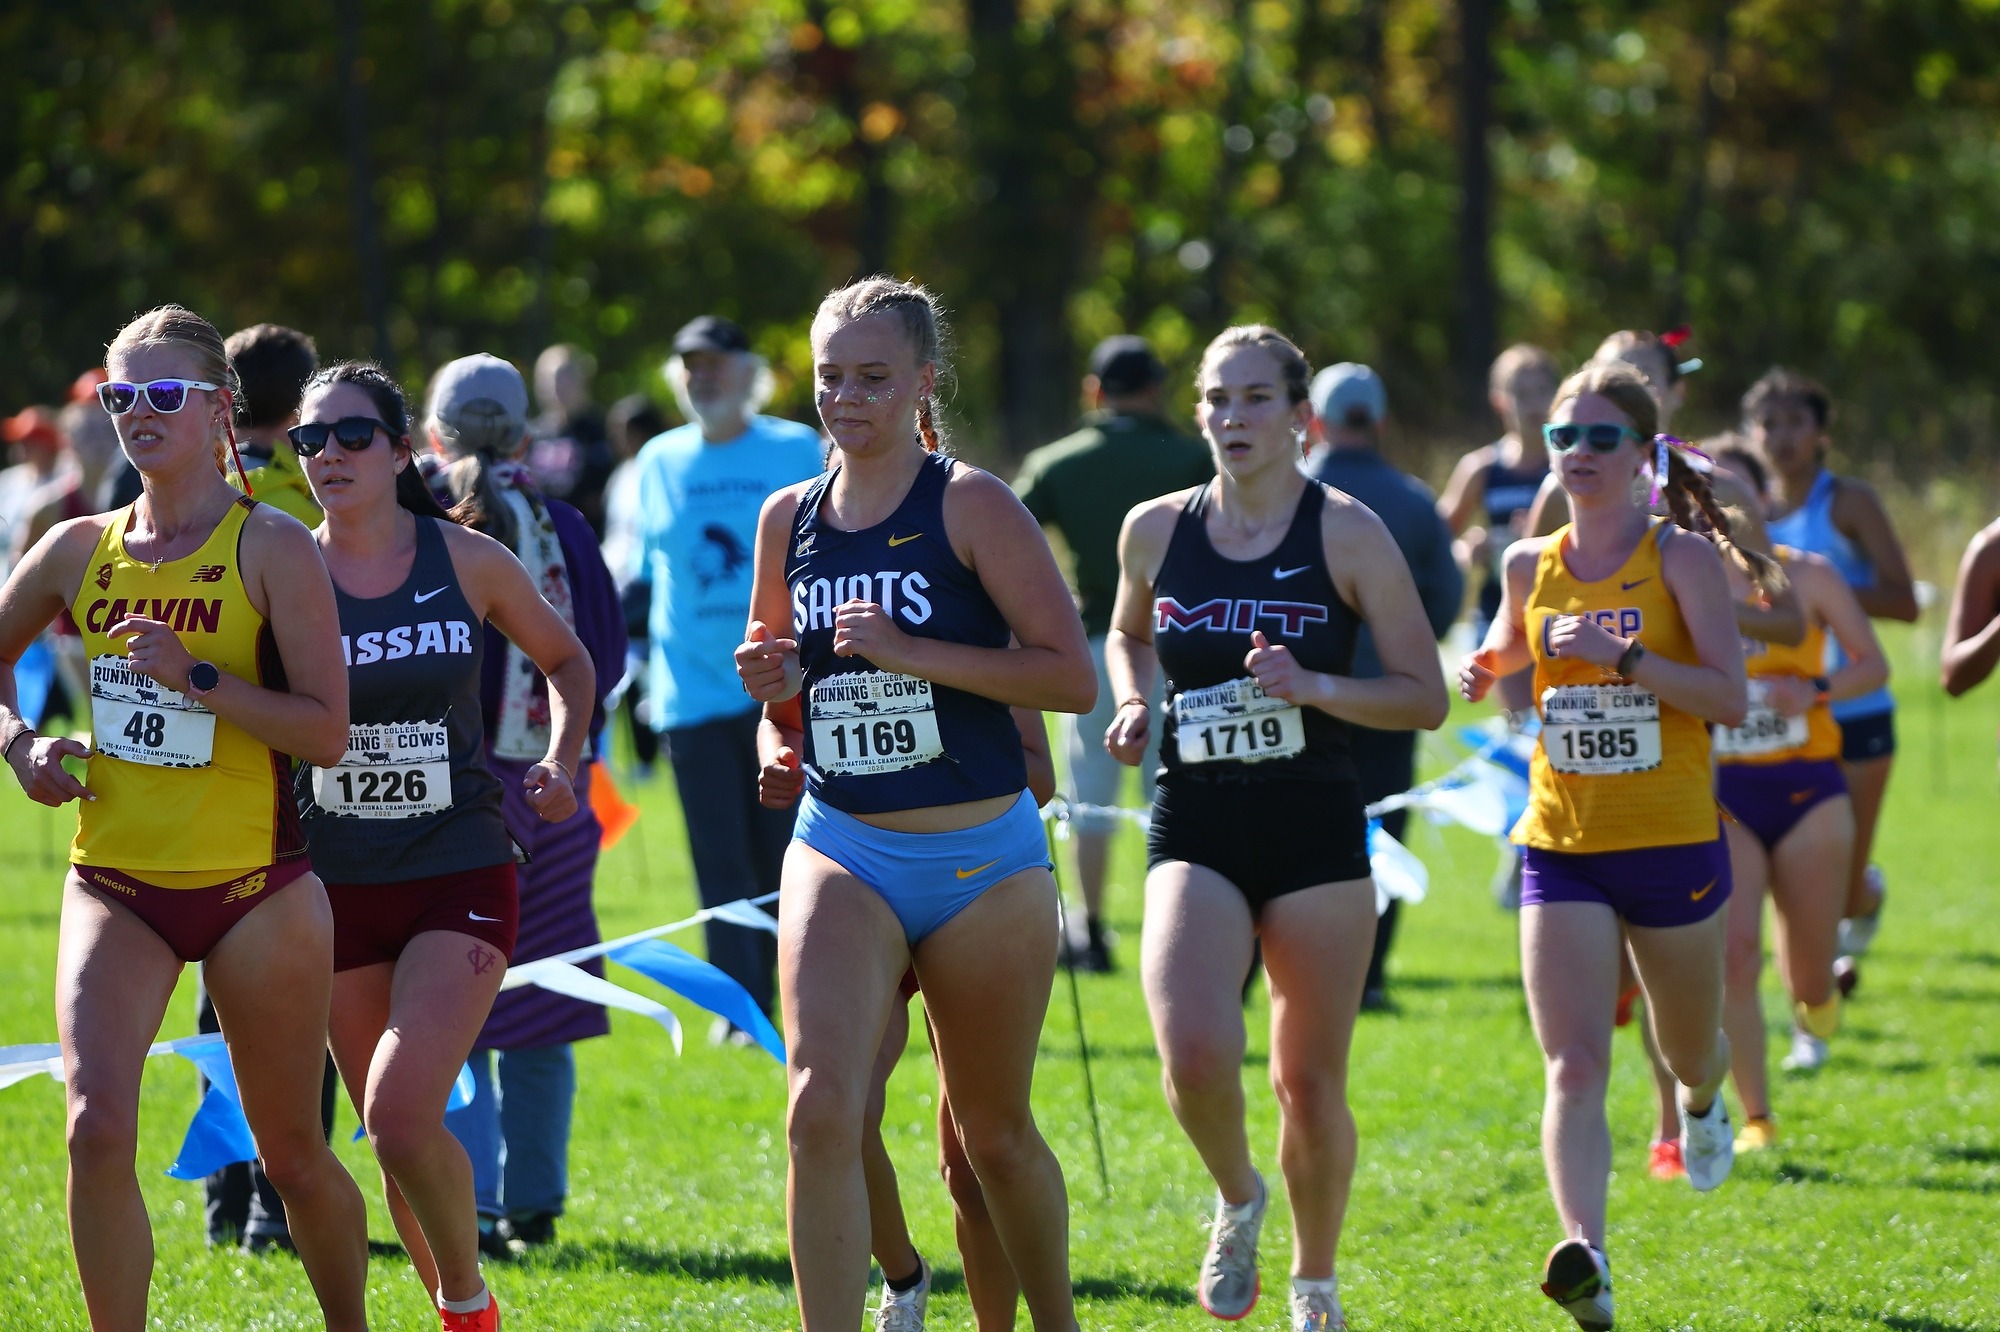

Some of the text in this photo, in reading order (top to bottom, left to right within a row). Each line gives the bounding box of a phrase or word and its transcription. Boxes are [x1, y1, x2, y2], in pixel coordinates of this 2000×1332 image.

[1153, 597, 1328, 637] MIT
[94, 665, 153, 688] RUNNING
[832, 674, 904, 686] CARLETON COLLEGE
[813, 680, 929, 703] RUNNING COWS
[1181, 691, 1237, 710] RUNNING
[1547, 696, 1598, 710] RUNNING
[1613, 694, 1657, 708] COWS
[123, 711, 166, 747] 48
[384, 726, 420, 734] COLLEGE
[398, 732, 445, 748] COWS
[831, 719, 917, 759] 1169
[1201, 717, 1283, 756] 1719
[143, 748, 191, 760] CHAMPIONSHIP
[1562, 727, 1639, 760] 1585
[878, 754, 924, 765] CHAMPIONSHIP
[337, 769, 427, 803] 1226
[94, 872, 137, 897] KNIGHTS
